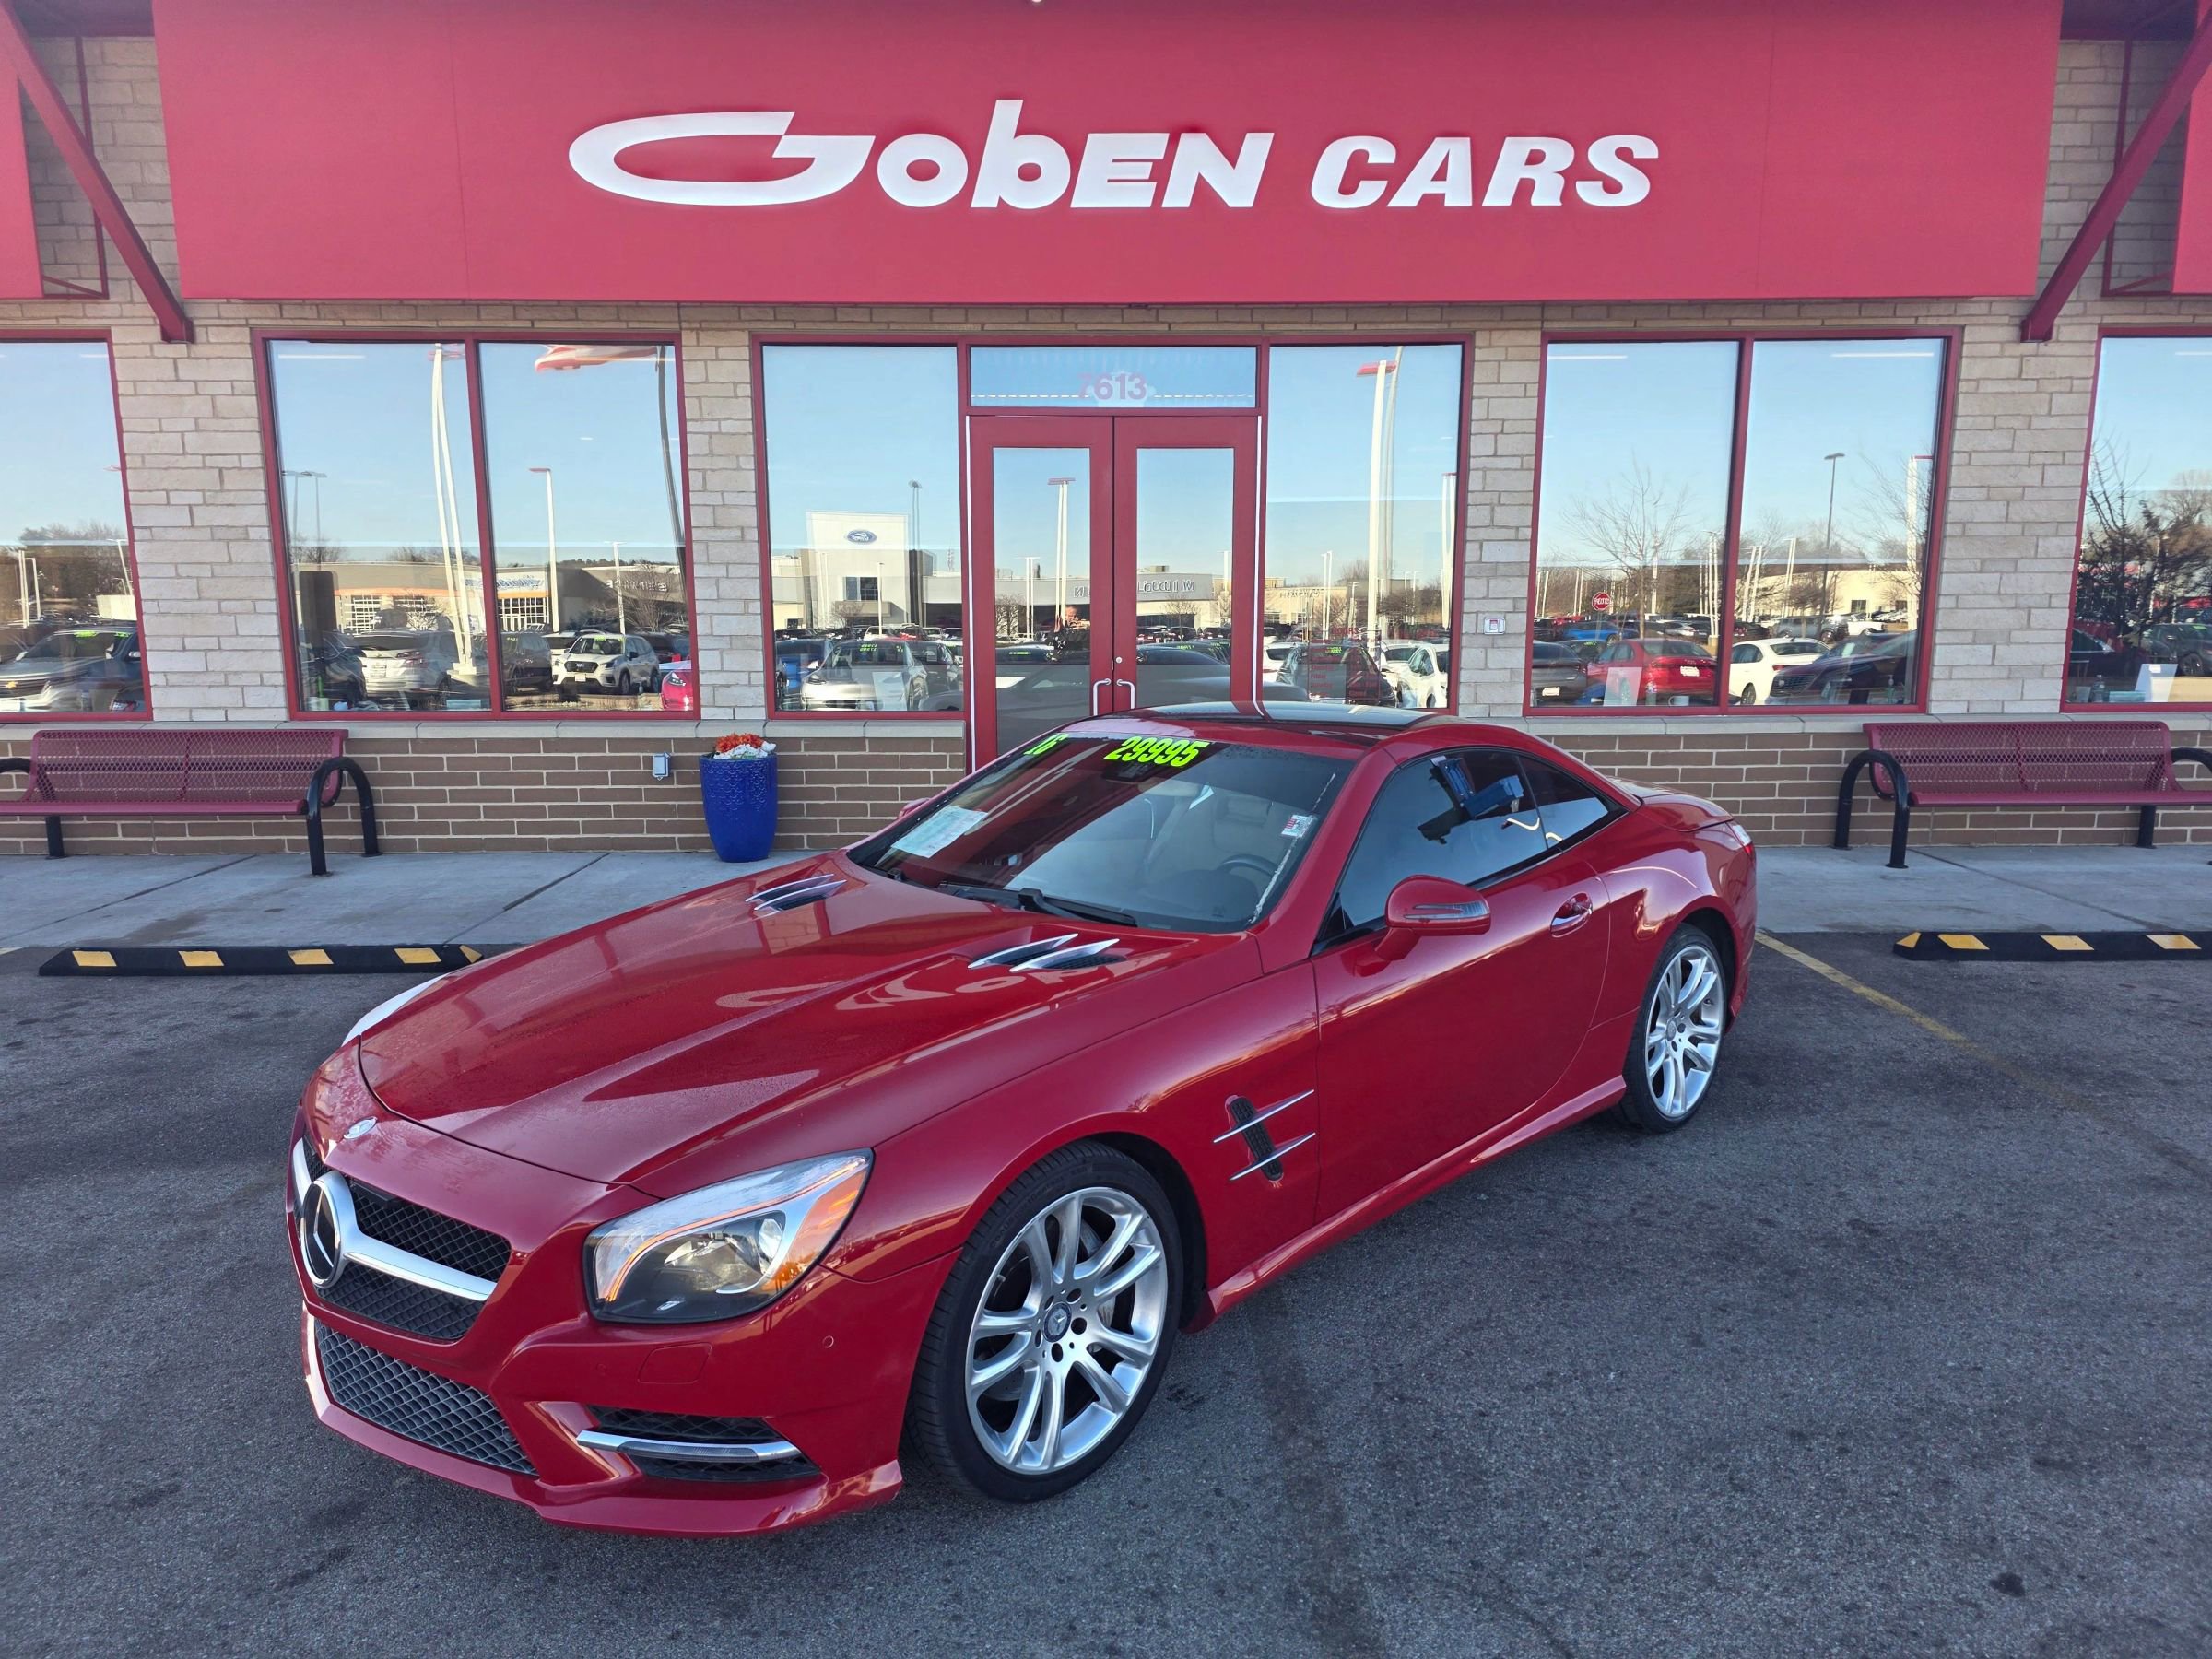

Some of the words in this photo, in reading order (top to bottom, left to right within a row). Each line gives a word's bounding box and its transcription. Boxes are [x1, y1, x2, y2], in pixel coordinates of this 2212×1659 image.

[1312, 135, 1659, 209] CARS
[1077, 372, 1147, 400] 7613
[1103, 736, 1210, 768] 29995
